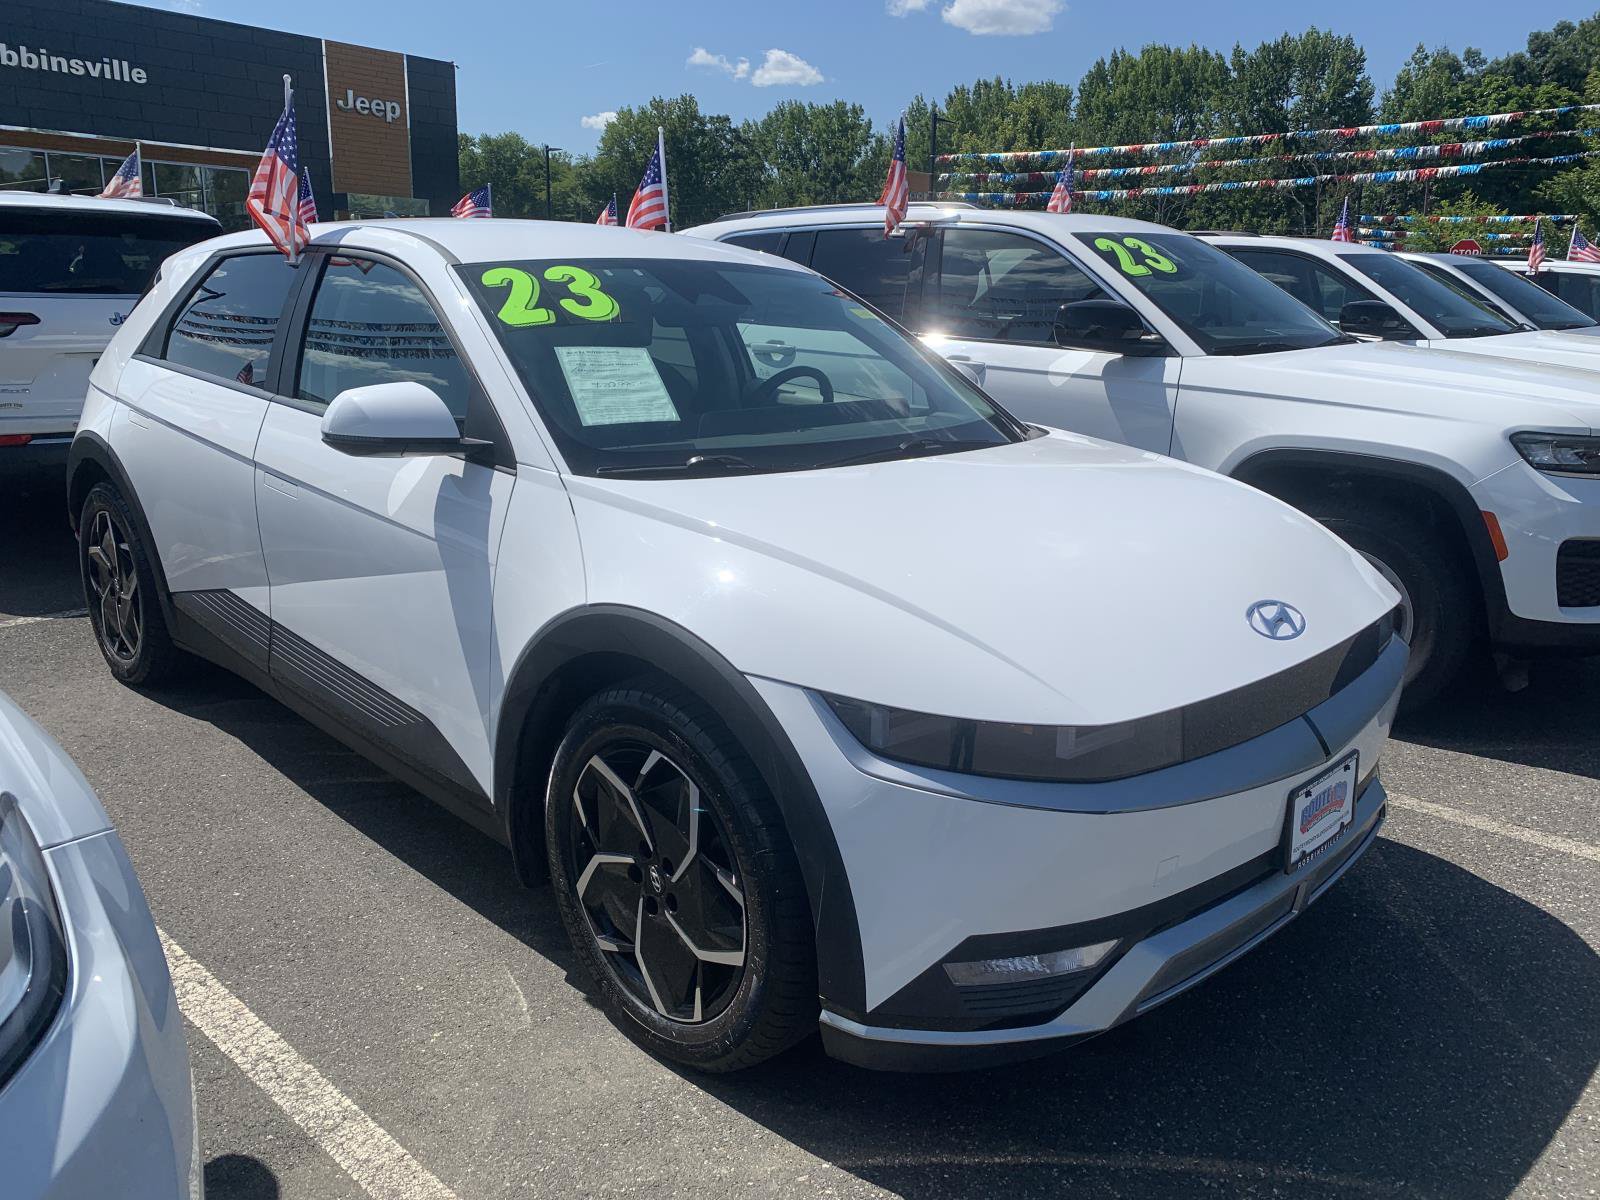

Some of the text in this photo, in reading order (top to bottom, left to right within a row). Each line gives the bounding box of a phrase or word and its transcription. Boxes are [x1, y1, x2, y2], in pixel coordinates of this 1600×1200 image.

[336, 88, 401, 124] Jeep
[1094, 237, 1177, 276] 23
[481, 265, 620, 327] 23
